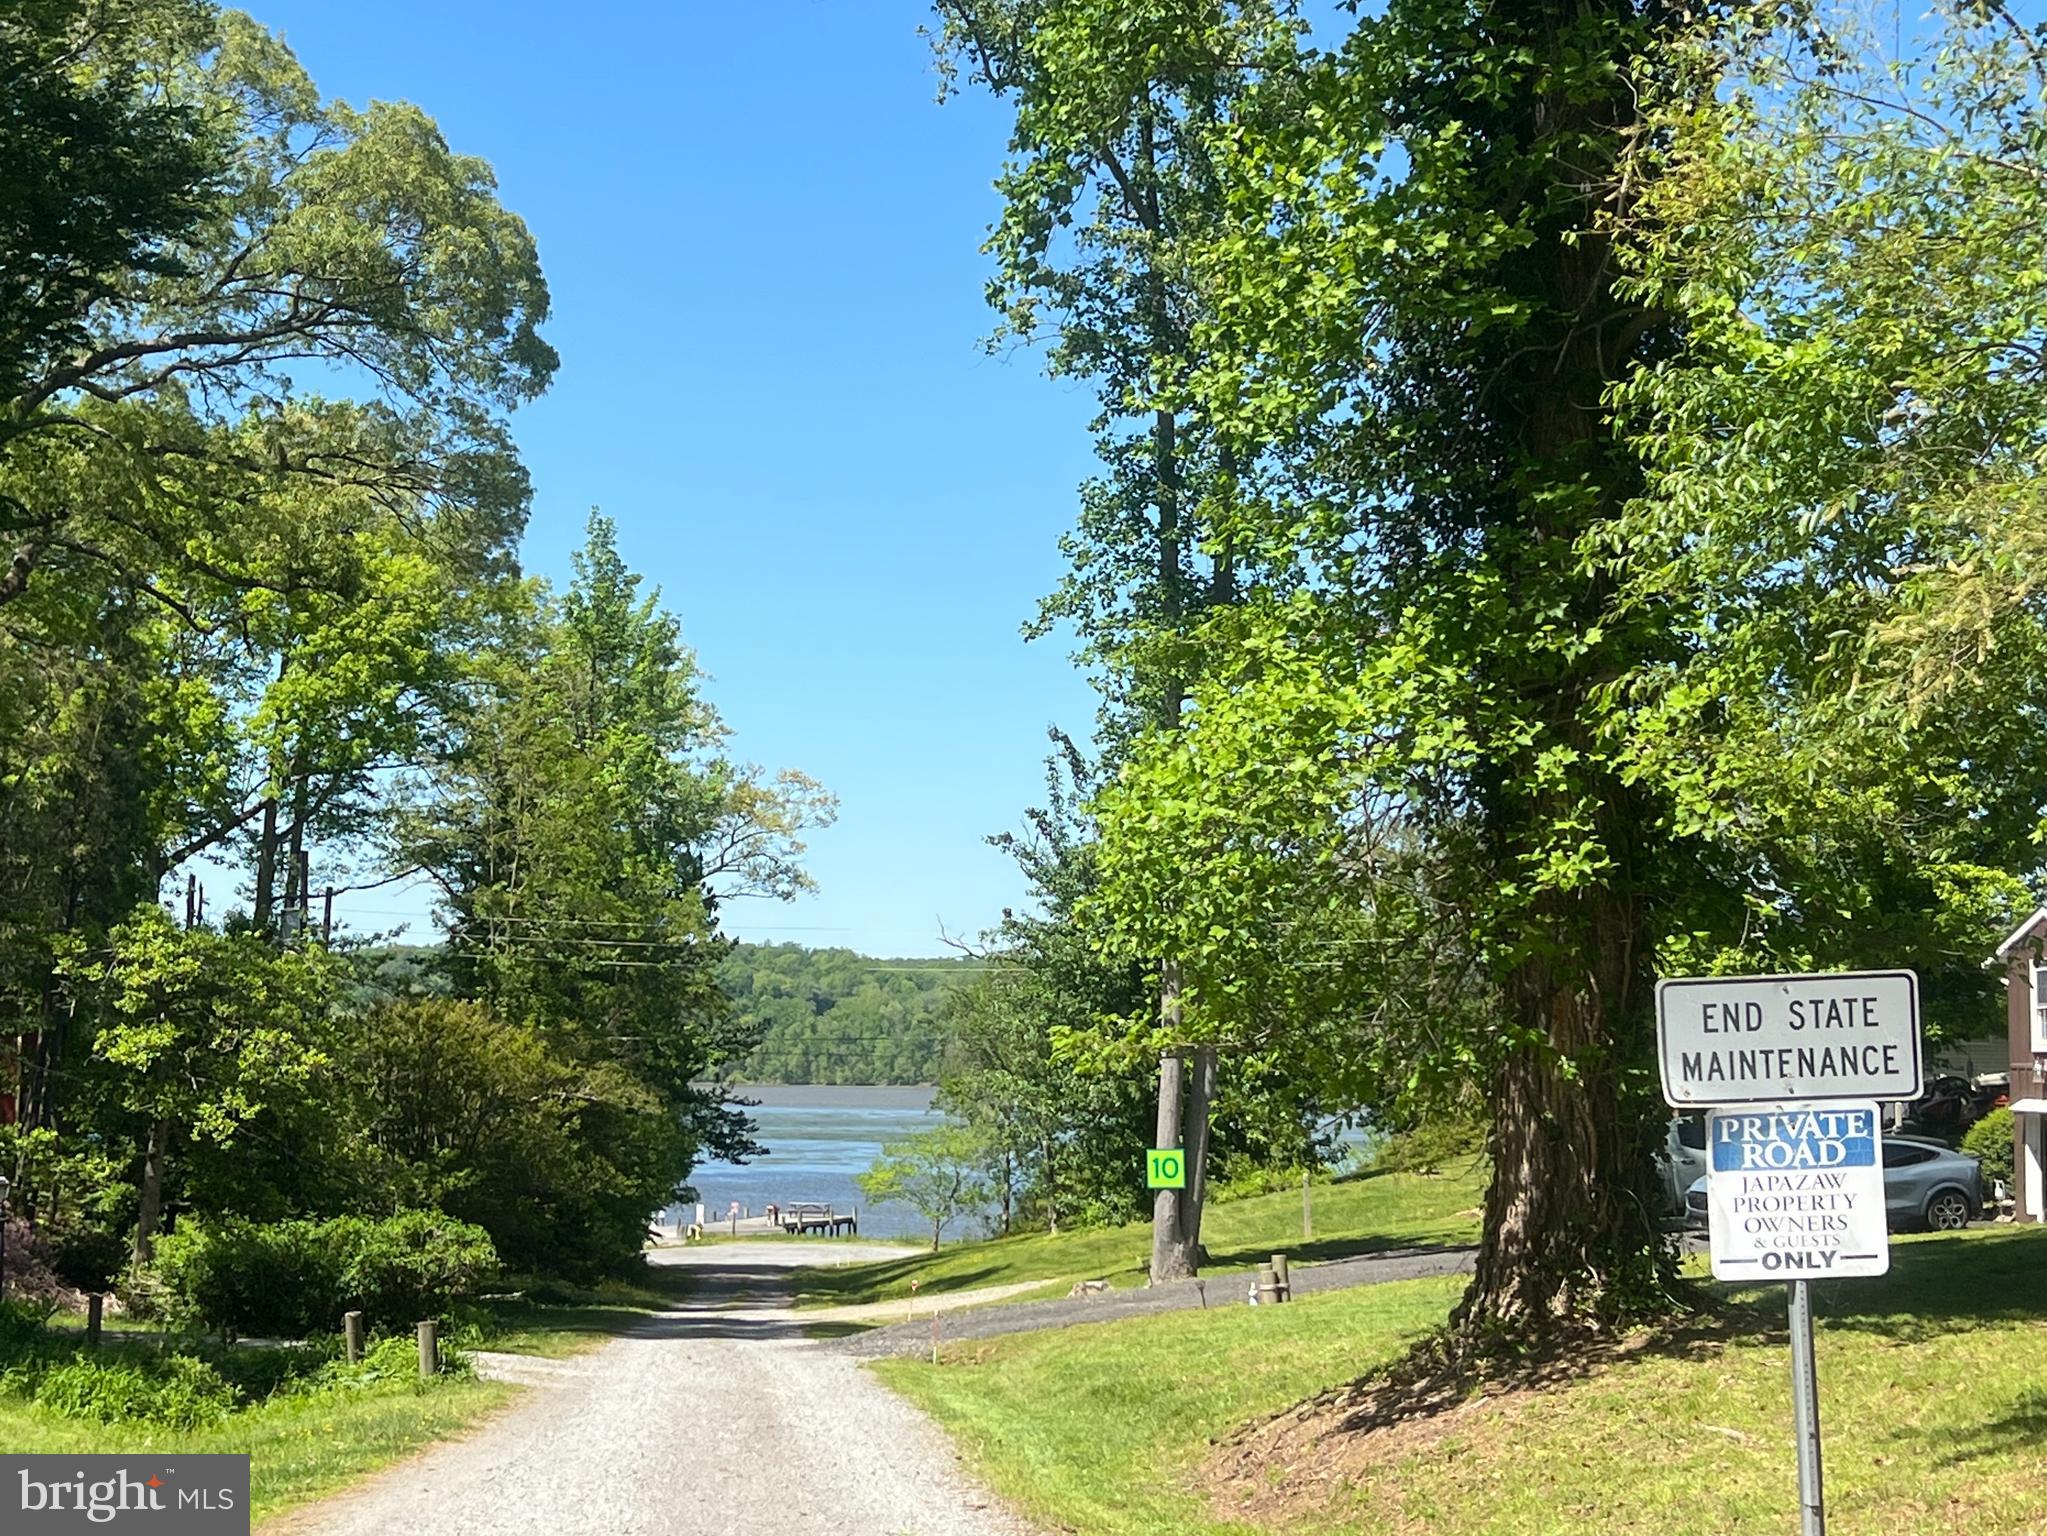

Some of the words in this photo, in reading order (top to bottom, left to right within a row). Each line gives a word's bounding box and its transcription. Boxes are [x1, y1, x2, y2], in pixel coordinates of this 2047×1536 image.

[1702, 1001, 1762, 1033] END
[1788, 997, 1879, 1031] STATE
[1681, 1044, 1899, 1082] MAINTENANCE
[1719, 1112, 1868, 1143] PRIVATE
[1741, 1140, 1846, 1169] ROAD
[1152, 1157, 1179, 1179] 10
[1742, 1173, 1847, 1195] JAPAZAW
[1733, 1192, 1858, 1214] PROPERTY
[1744, 1214, 1848, 1234] OWNERS
[1753, 1237, 1767, 1249] &
[1772, 1234, 1841, 1249] GUESTS
[1761, 1250, 1837, 1270] ONLY
